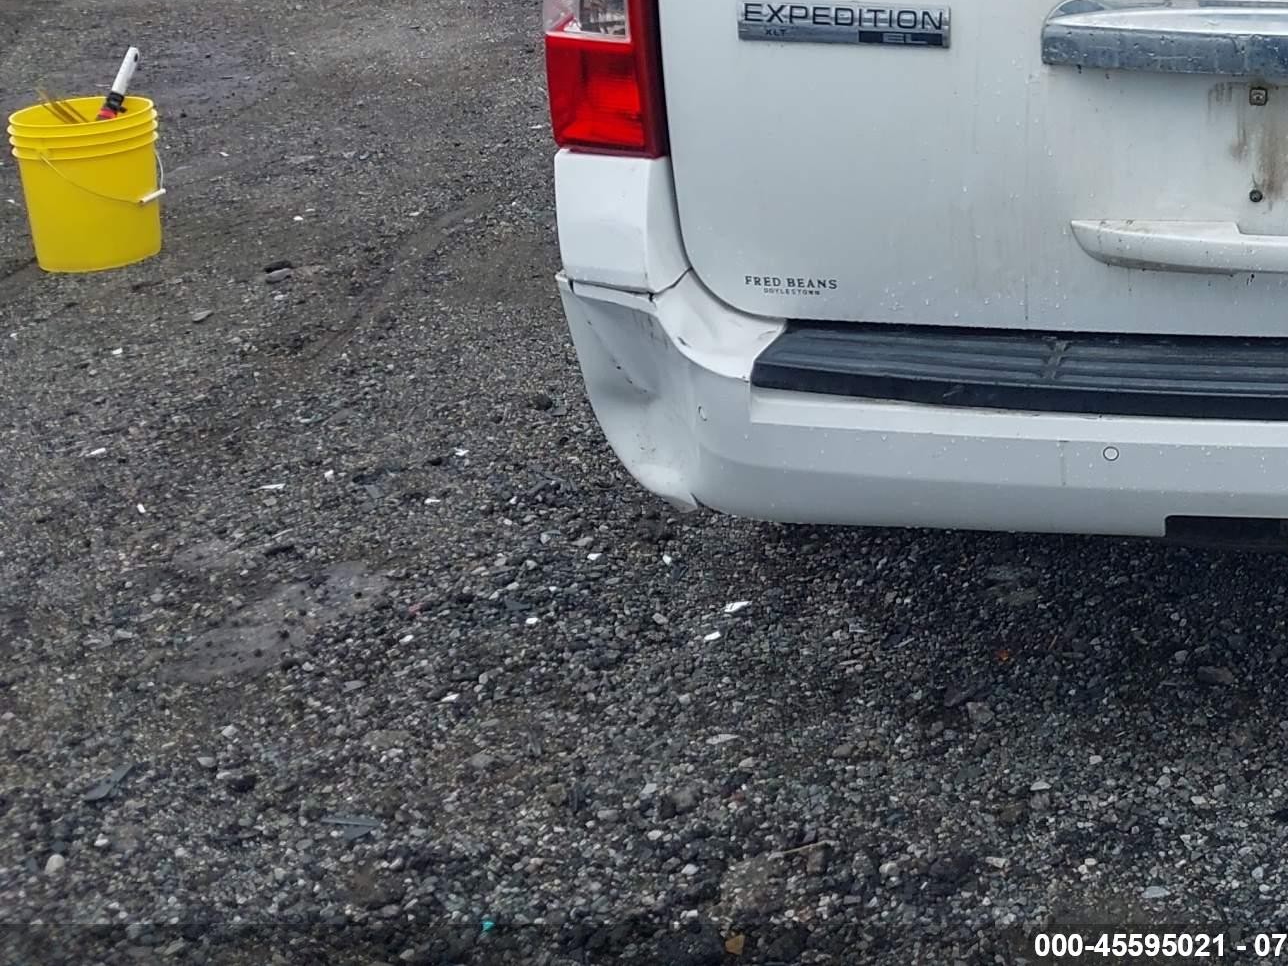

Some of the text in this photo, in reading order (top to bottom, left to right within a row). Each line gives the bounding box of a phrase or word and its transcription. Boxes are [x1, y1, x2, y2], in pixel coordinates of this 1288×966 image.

[744, 2, 943, 30] EXPEDITION
[766, 28, 927, 44] XLT EL
[744, 275, 838, 290] FRED BEANS
